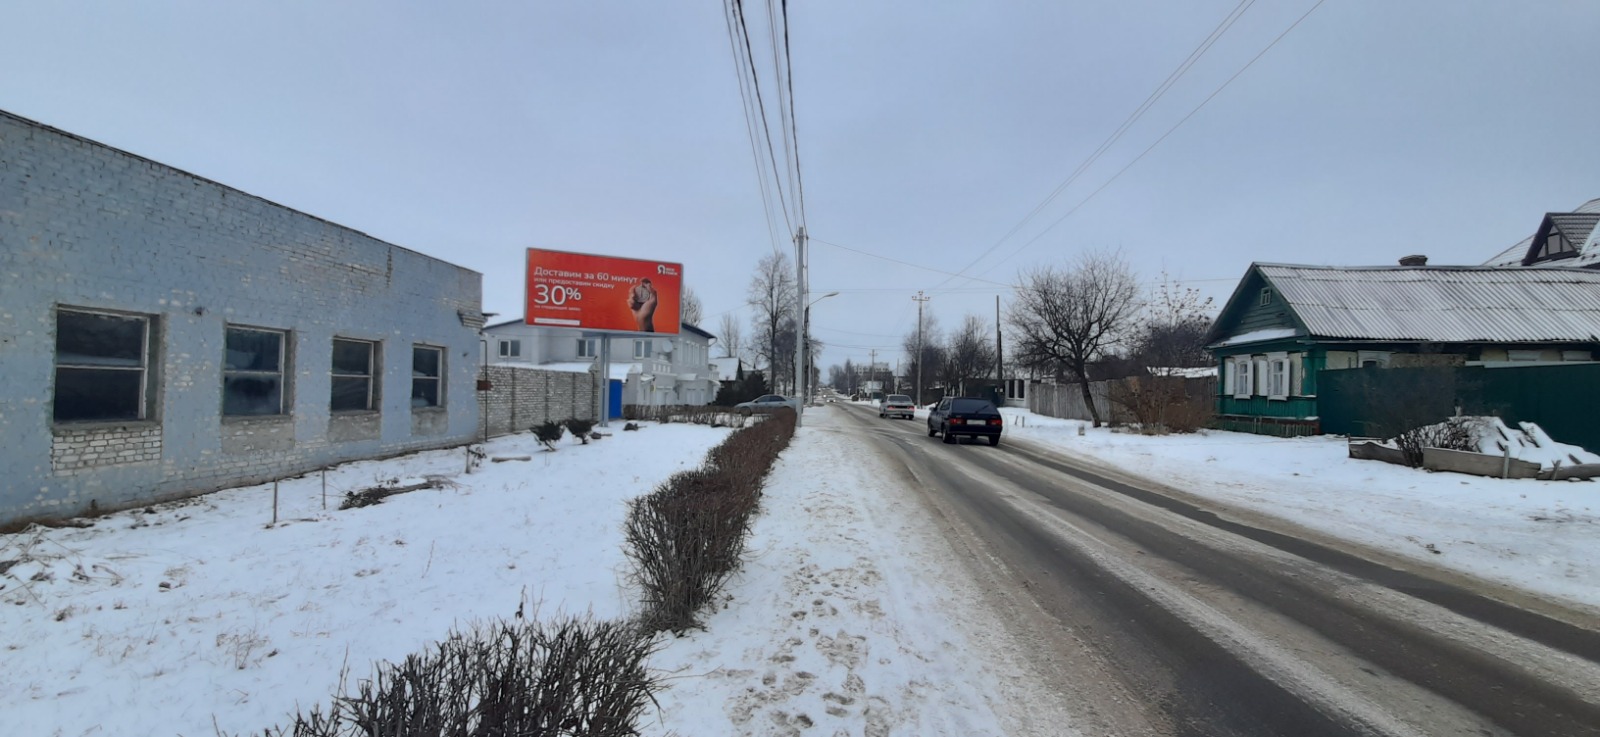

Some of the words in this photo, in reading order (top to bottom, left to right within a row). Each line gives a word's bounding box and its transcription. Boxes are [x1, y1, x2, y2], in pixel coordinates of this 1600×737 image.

[534, 266, 582, 278] Доставим
[584, 272, 594, 280] за
[597, 272, 609, 281] 60
[611, 275, 638, 284] минут
[548, 279, 591, 287] предоставим
[533, 283, 582, 305] 30%
